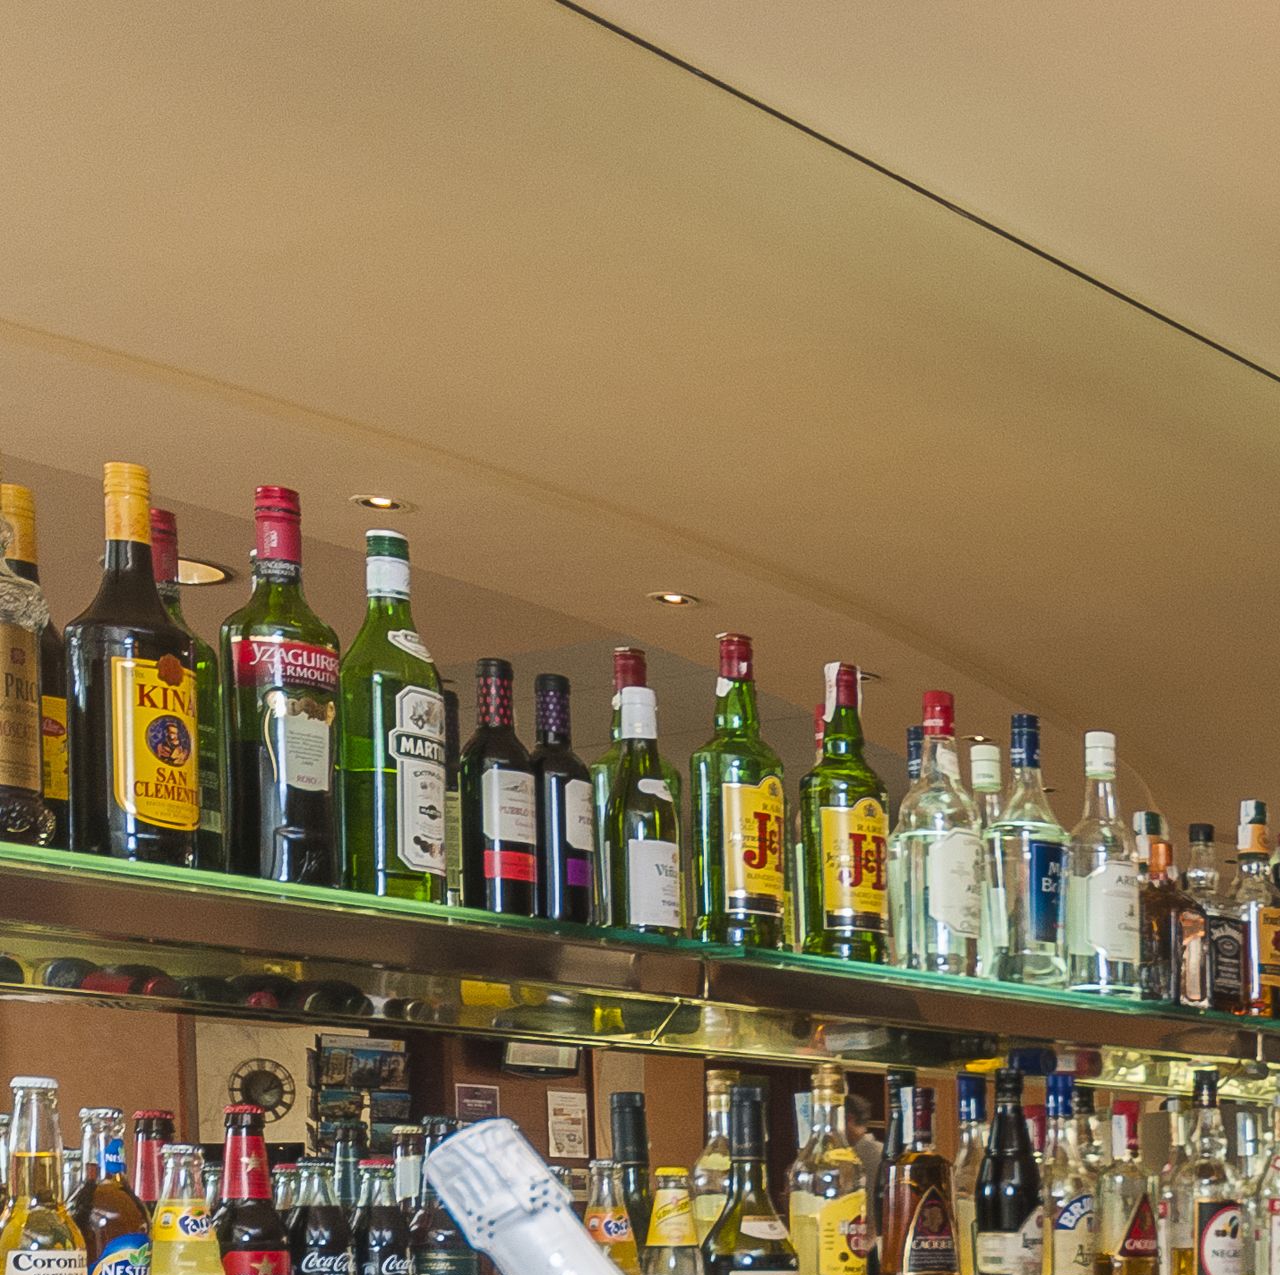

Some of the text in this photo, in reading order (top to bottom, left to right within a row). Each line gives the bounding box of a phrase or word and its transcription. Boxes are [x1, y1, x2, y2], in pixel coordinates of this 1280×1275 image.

[268, 663, 336, 684] VERMOUTH
[400, 736, 443, 761] MART
[156, 768, 187, 786] SAN
